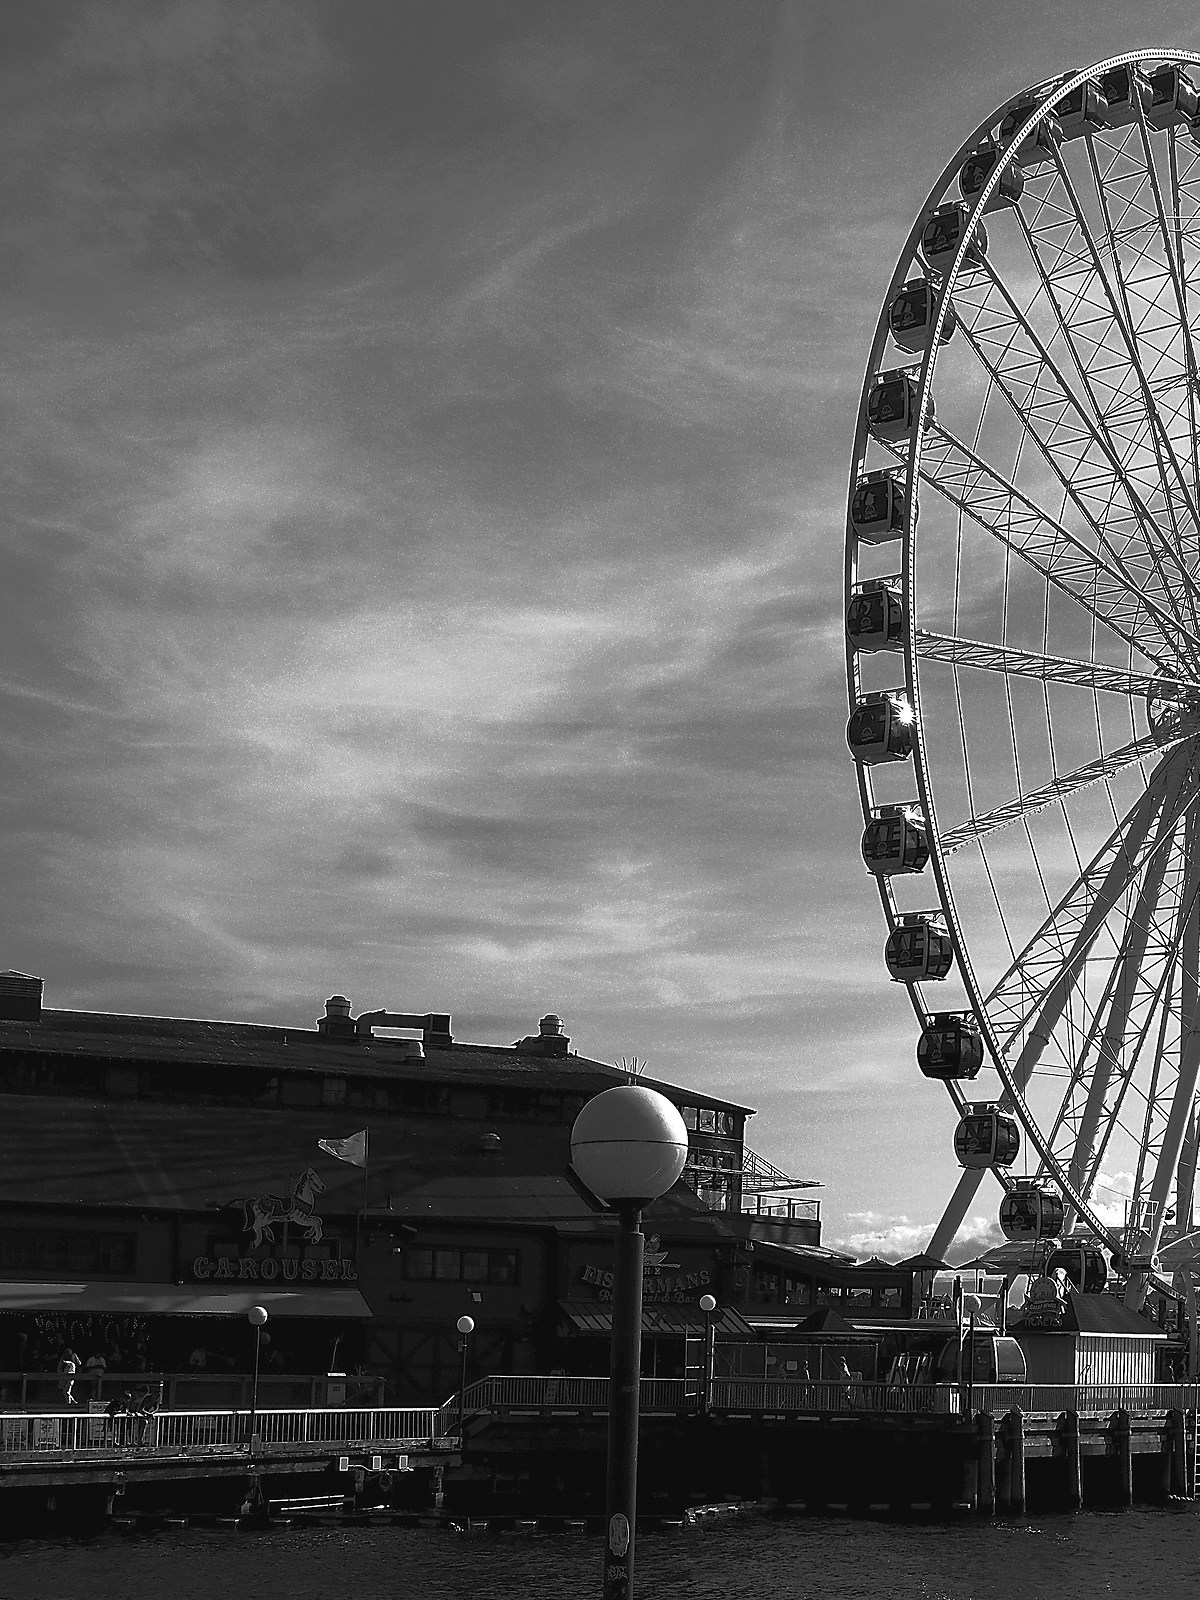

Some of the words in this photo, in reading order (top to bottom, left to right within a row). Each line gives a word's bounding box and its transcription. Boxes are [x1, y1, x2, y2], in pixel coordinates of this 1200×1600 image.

[193, 1256, 358, 1280] CAROUSEL
[582, 1264, 711, 1294] FISRMANS
[661, 1292, 671, 1303] &
[674, 1291, 696, 1304] Bar
